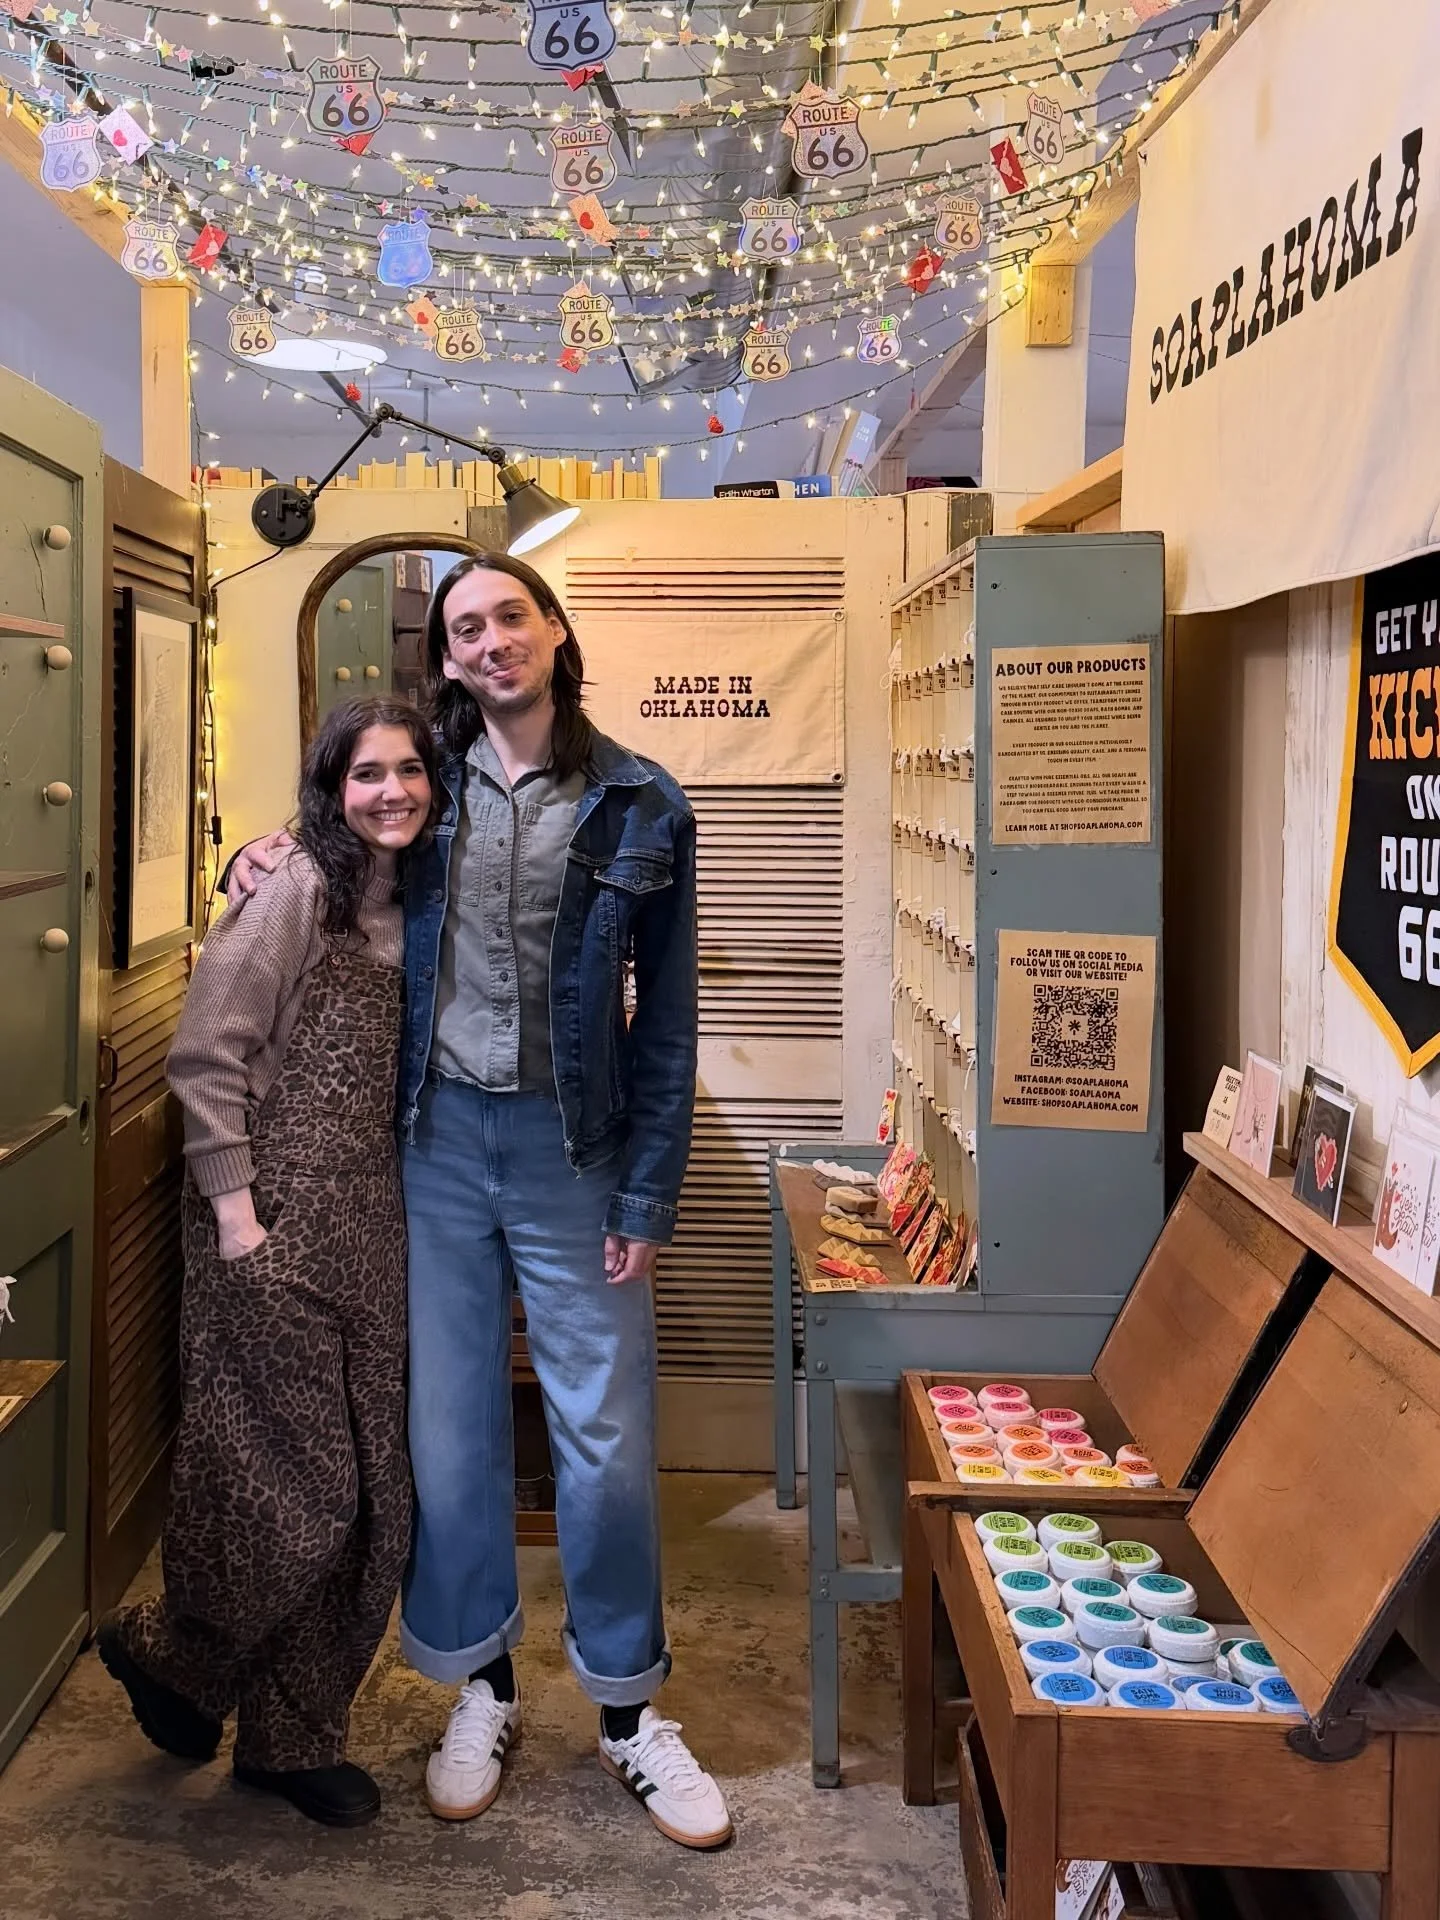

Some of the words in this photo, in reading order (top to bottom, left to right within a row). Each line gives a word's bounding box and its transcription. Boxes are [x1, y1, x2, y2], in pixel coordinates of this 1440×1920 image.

[560, 8, 580, 18] US
[546, 16, 599, 58] 66
[320, 64, 366, 79] ROUTE
[336, 85, 352, 94] US
[322, 94, 370, 127] 66
[803, 106, 850, 122] ROUTE
[1034, 100, 1057, 118] ROUTE
[52, 124, 88, 138] ROUTE
[820, 128, 836, 136] US
[1042, 120, 1050, 128] US
[562, 130, 601, 144] ROUTE
[1034, 126, 1057, 158] 66
[808, 134, 854, 170] 66
[54, 151, 89, 181] 66
[564, 156, 604, 186] 66
[752, 206, 788, 216] ROUTE
[946, 202, 974, 212] ROUTE
[134, 227, 168, 239] ROUTE
[751, 227, 788, 252] 66
[945, 221, 973, 244] 66
[134, 247, 168, 271] 66
[1149, 127, 1423, 404] SOAPLAHOMA
[569, 300, 601, 310] ROUTE
[236, 312, 268, 322] ROUTE
[442, 314, 472, 324] ROUTE
[570, 321, 604, 344] 66
[866, 320, 893, 331] ROUTE
[240, 330, 268, 349] 66
[446, 333, 474, 356] 66
[752, 336, 780, 344] ROUTE
[866, 338, 892, 358] 66
[752, 354, 780, 374] 66
[741, 488, 774, 498] Wharton
[1376, 604, 1417, 654] GET
[1422, 599, 1440, 647] Y
[996, 662, 1042, 676] ABOUT
[1047, 662, 1073, 674] OUR
[1078, 658, 1146, 672] PRODUCTS
[654, 676, 720, 694] MADE
[729, 676, 752, 694] IN
[640, 699, 770, 718] OKLAHOMA
[1407, 776, 1440, 820] ON
[1060, 822, 1142, 830] SHOPSOAPLAHOMA.COM
[1381, 836, 1440, 896] ROU
[1400, 906, 1440, 986] 66
[1027, 948, 1052, 958] SCAN
[1056, 950, 1071, 958] THE
[1074, 950, 1085, 959] QR
[1088, 952, 1112, 960] CODE
[1116, 952, 1126, 961] TO
[1010, 958, 1046, 968] FOLLOW
[1050, 960, 1060, 968] US
[1064, 960, 1076, 968] ON
[1079, 961, 1111, 970] SOCIAL
[1114, 962, 1143, 972] MEDIA
[1026, 968, 1038, 976] OR
[1041, 969, 1061, 978] VISIT
[1066, 970, 1082, 978] OUR
[1085, 971, 1128, 980] WEBSITE!
[1014, 1074, 1064, 1084] INSTAGRAM:
[1066, 1077, 1128, 1088] @SOAPLAHOMA
[1021, 1086, 1068, 1096] FACEBOOK:
[1070, 1089, 1120, 1099] SOAPLAOMA
[1003, 1097, 1040, 1106] WEBSITE:
[1042, 1098, 1138, 1112] SHOPSOAPLAHOMA.COM
